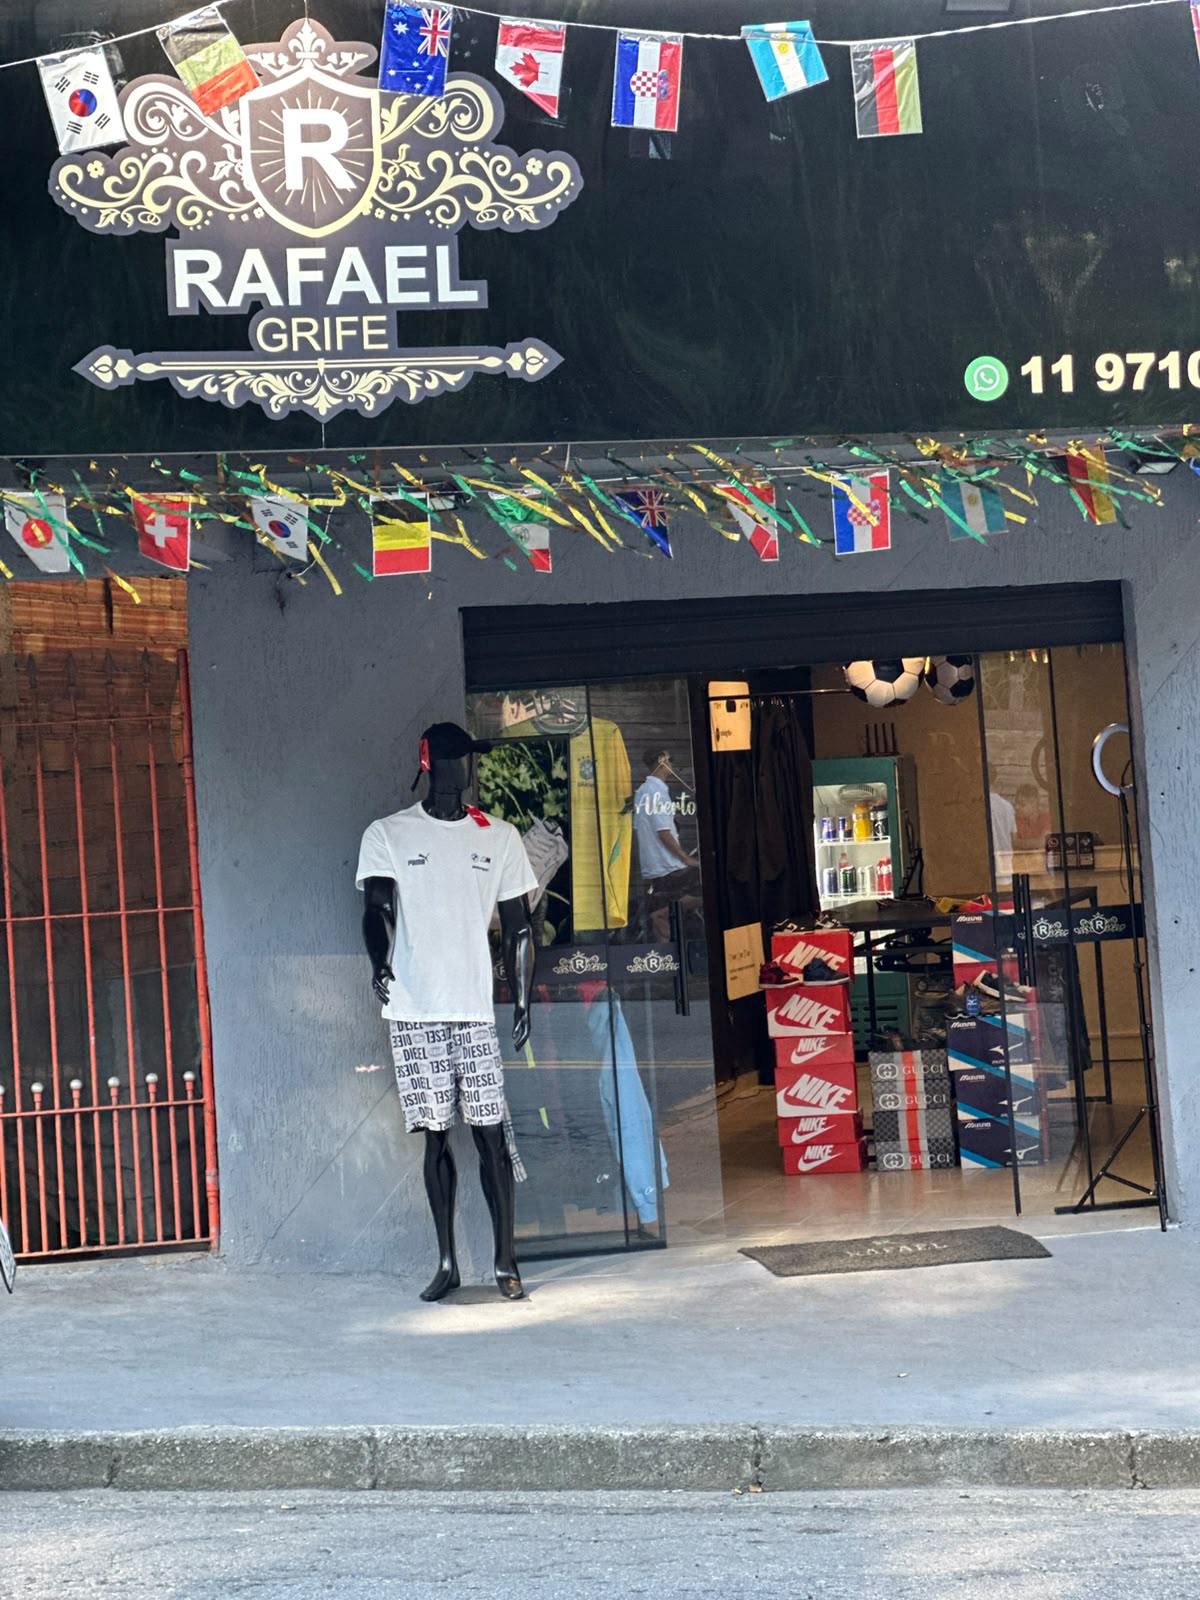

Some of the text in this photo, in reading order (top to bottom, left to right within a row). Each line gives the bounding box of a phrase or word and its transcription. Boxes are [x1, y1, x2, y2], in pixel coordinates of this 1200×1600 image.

[282, 108, 357, 190] R
[173, 245, 479, 308] RAFAEL
[256, 315, 389, 352] GRIFE
[1020, 354, 1074, 394] 11
[634, 791, 697, 816] Aberto
[1039, 925, 1048, 936] R
[1096, 920, 1104, 931] R
[575, 958, 585, 969] R
[782, 941, 847, 970] NIKE
[649, 958, 658, 970] R
[778, 993, 842, 1031] NIKE
[462, 1043, 493, 1059] DIESEL
[797, 1036, 827, 1052] NIKE
[902, 1064, 944, 1075] GUCCI
[465, 1073, 498, 1088] DIESEL
[787, 1073, 853, 1110] NIKE
[904, 1094, 947, 1105] GUCCI
[470, 1102, 500, 1118] DIESEL
[798, 1117, 828, 1132] NIKE
[804, 1145, 834, 1160] NIKE
[909, 1153, 951, 1165] GUCCI
